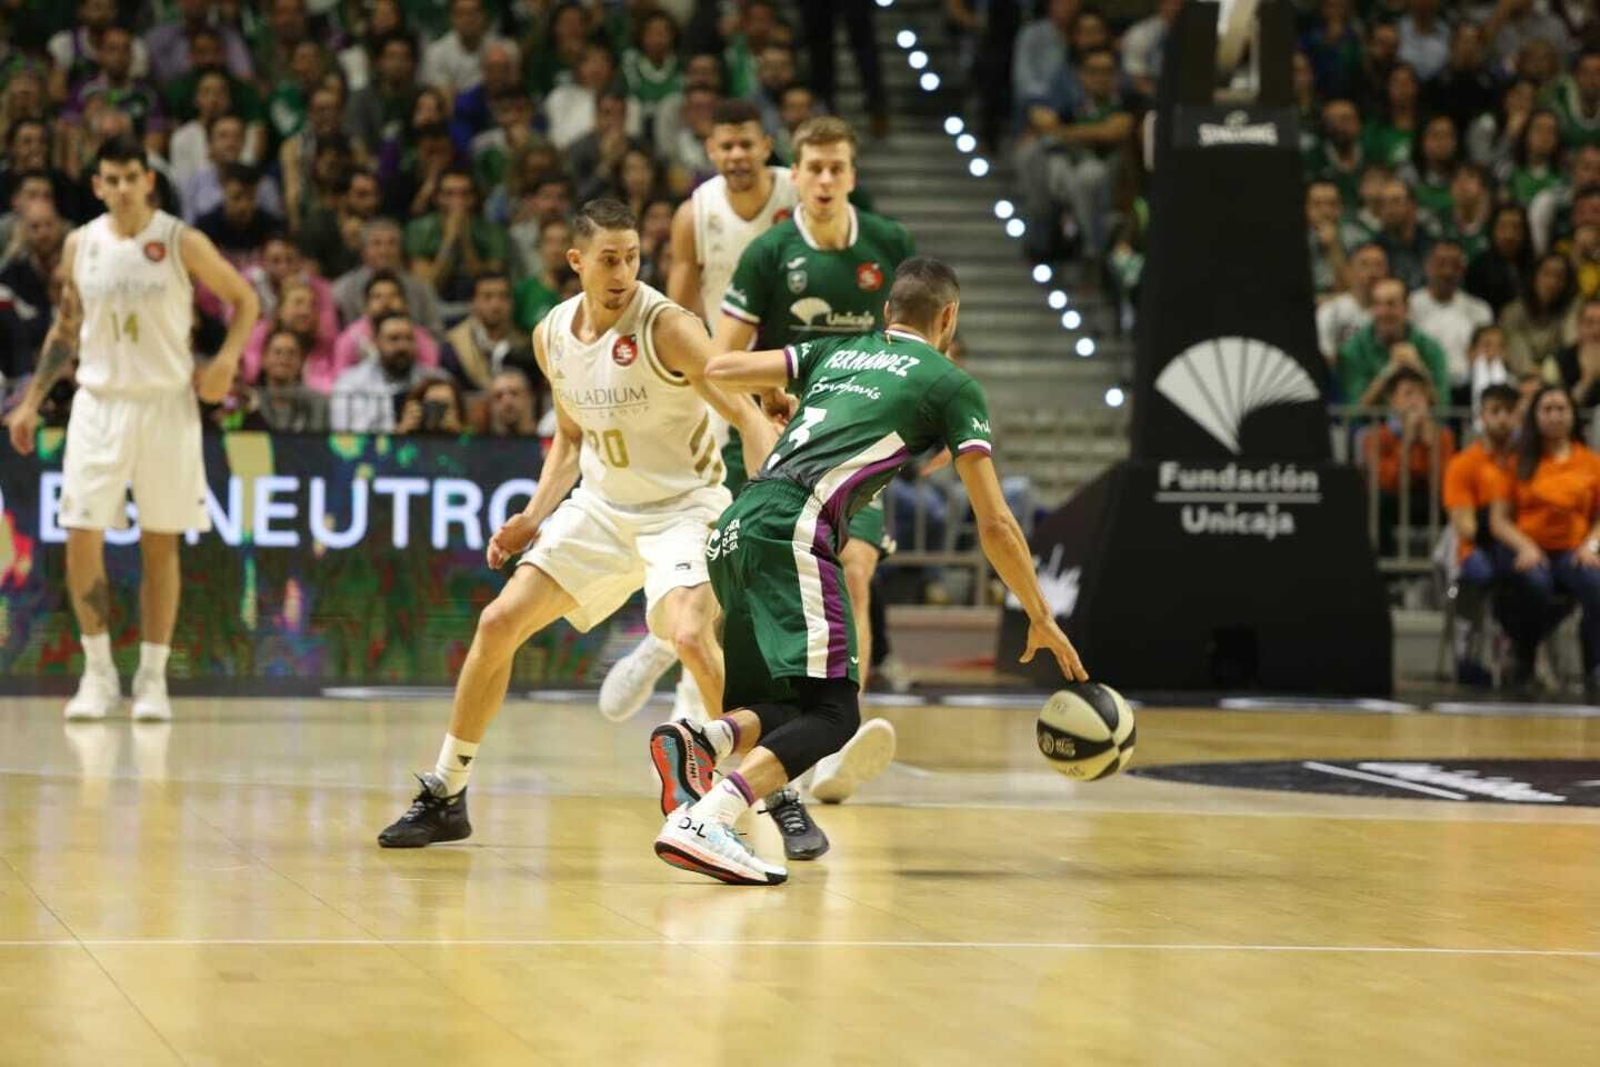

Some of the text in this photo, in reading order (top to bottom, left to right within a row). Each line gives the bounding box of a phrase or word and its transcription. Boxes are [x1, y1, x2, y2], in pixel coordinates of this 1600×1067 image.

[111, 312, 139, 343] 14
[1159, 461, 1319, 491] Fundación
[1181, 502, 1296, 541] Unicaja
